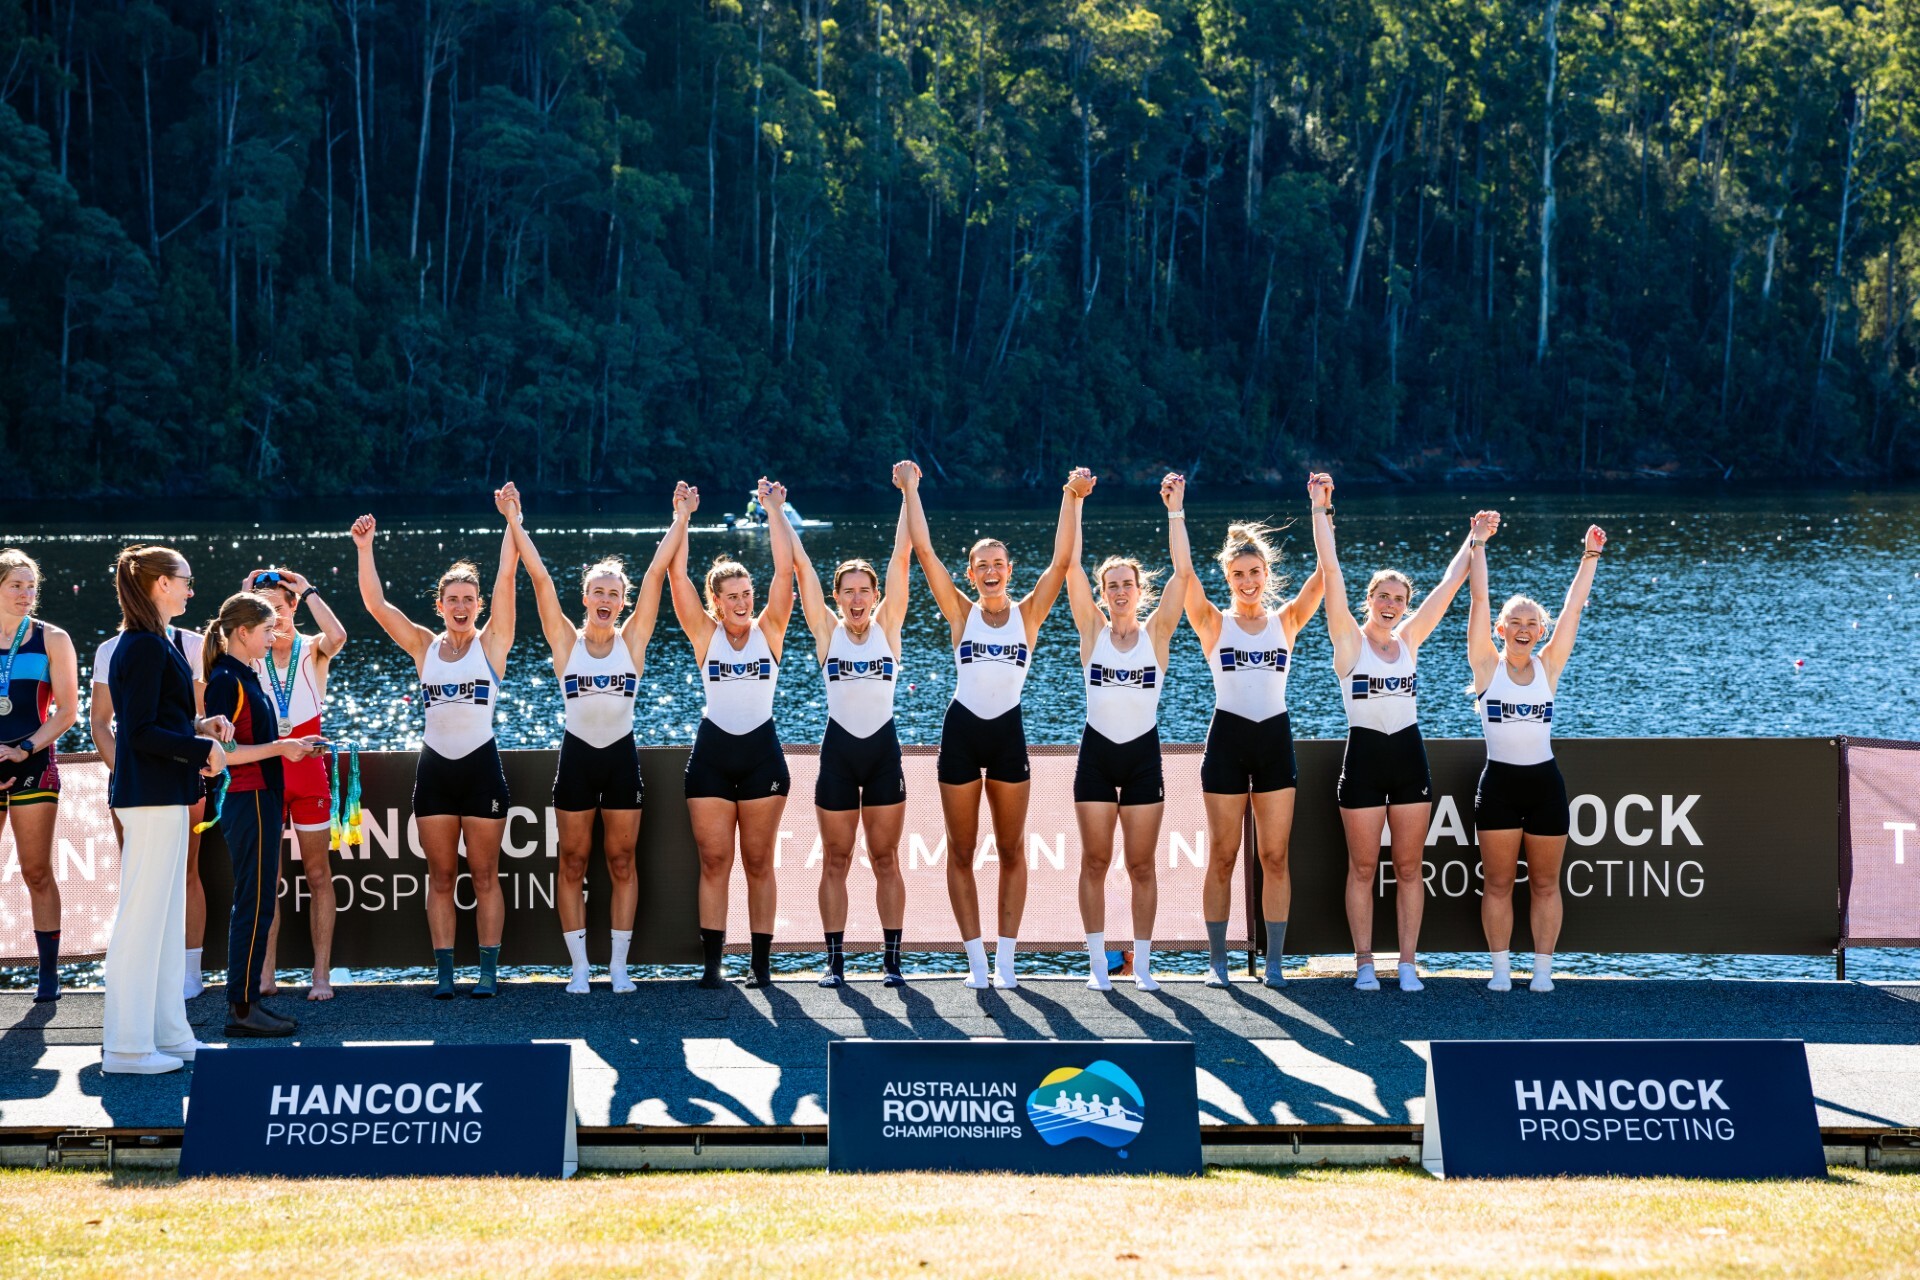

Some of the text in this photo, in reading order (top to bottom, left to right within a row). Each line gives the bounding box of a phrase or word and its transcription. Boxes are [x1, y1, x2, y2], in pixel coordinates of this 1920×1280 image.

[283, 805, 560, 861] NCCK
[1379, 793, 1704, 847] AOCK
[278, 872, 590, 914] ROSPCIN
[1379, 859, 1706, 898] PROSPCTING
[269, 1082, 484, 1116] HANCOCK
[882, 1081, 1017, 1098] AUSTRALIAN
[1514, 1079, 1731, 1111] HANCOCK
[882, 1100, 1015, 1123] ROWING
[265, 1120, 482, 1146] PROSPECTING
[882, 1125, 1023, 1139] CHAMPIONSHIPS
[1518, 1117, 1736, 1142] PROSPECTING
